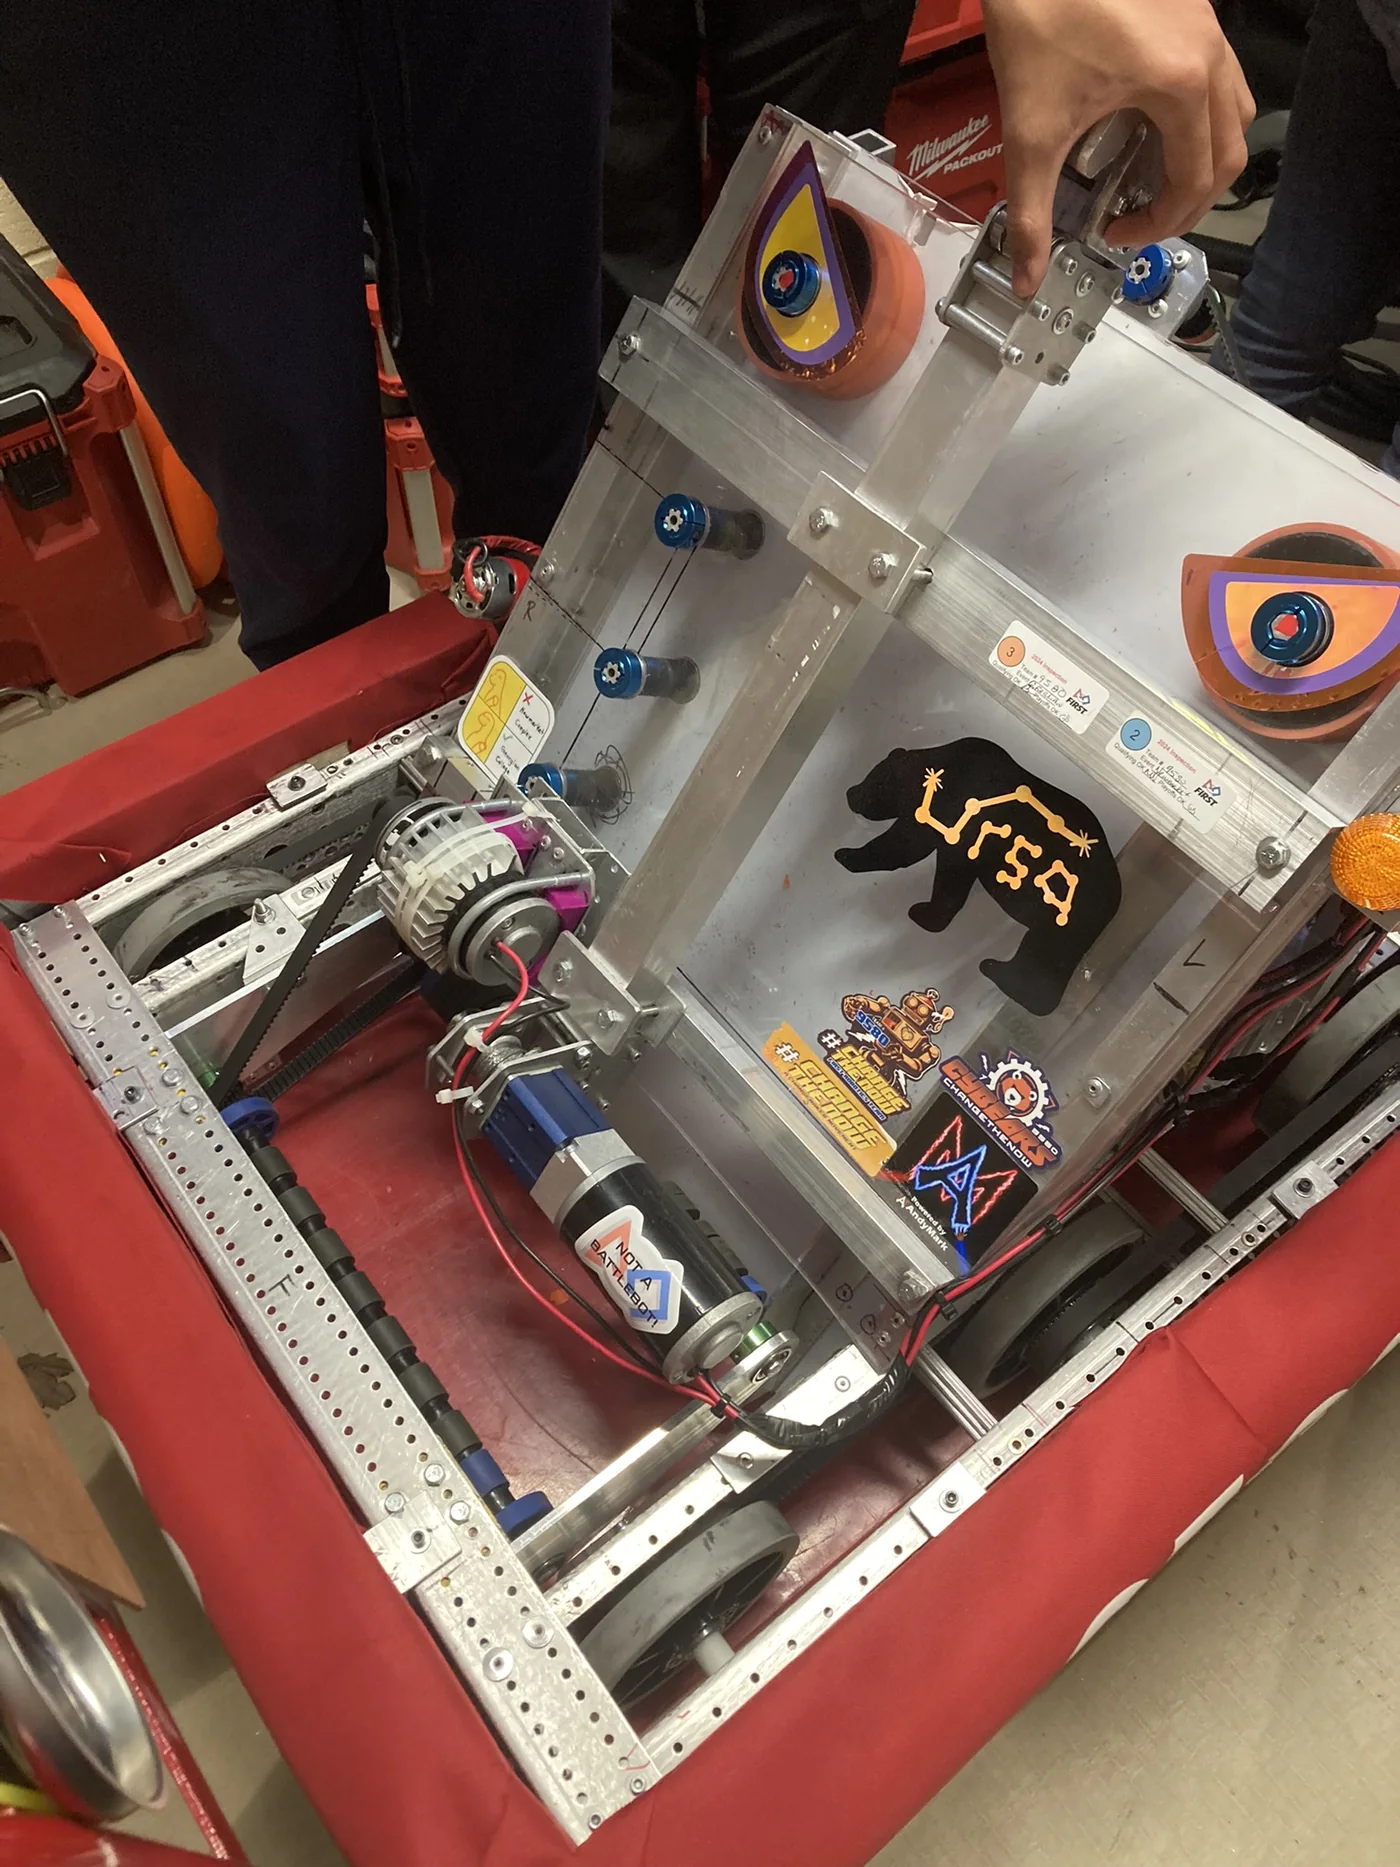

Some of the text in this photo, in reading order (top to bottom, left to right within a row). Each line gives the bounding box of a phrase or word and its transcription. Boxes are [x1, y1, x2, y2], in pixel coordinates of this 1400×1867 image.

[906, 114, 989, 176] Milwaukee
[943, 143, 1004, 175] PACKOUT
[1006, 646, 1016, 658] 3
[992, 660, 1013, 680] Qualifying
[1016, 670, 1030, 682] Event
[1020, 664, 1034, 677] Team
[1031, 654, 1068, 684] 2024 Inspection
[1066, 697, 1088, 715] FIRST
[1130, 729, 1141, 742] 2
[1114, 742, 1136, 765] Qualifying
[1158, 780, 1177, 799] Playoffs
[1140, 755, 1155, 768] Event
[1145, 749, 1159, 763] Team
[1157, 739, 1197, 774] 2024 Inspection
[1194, 786, 1218, 807] FIRST
[855, 1009, 891, 1047] 9580
[941, 1059, 1057, 1167] CYBEARS
[943, 1077, 1033, 1168] CHANGETHENOW
[906, 1204, 948, 1251] AndyMark
[910, 1195, 947, 1236] Powered by
[615, 1241, 653, 1290] NOT A
[590, 1238, 659, 1328] BATTLEBOT!
